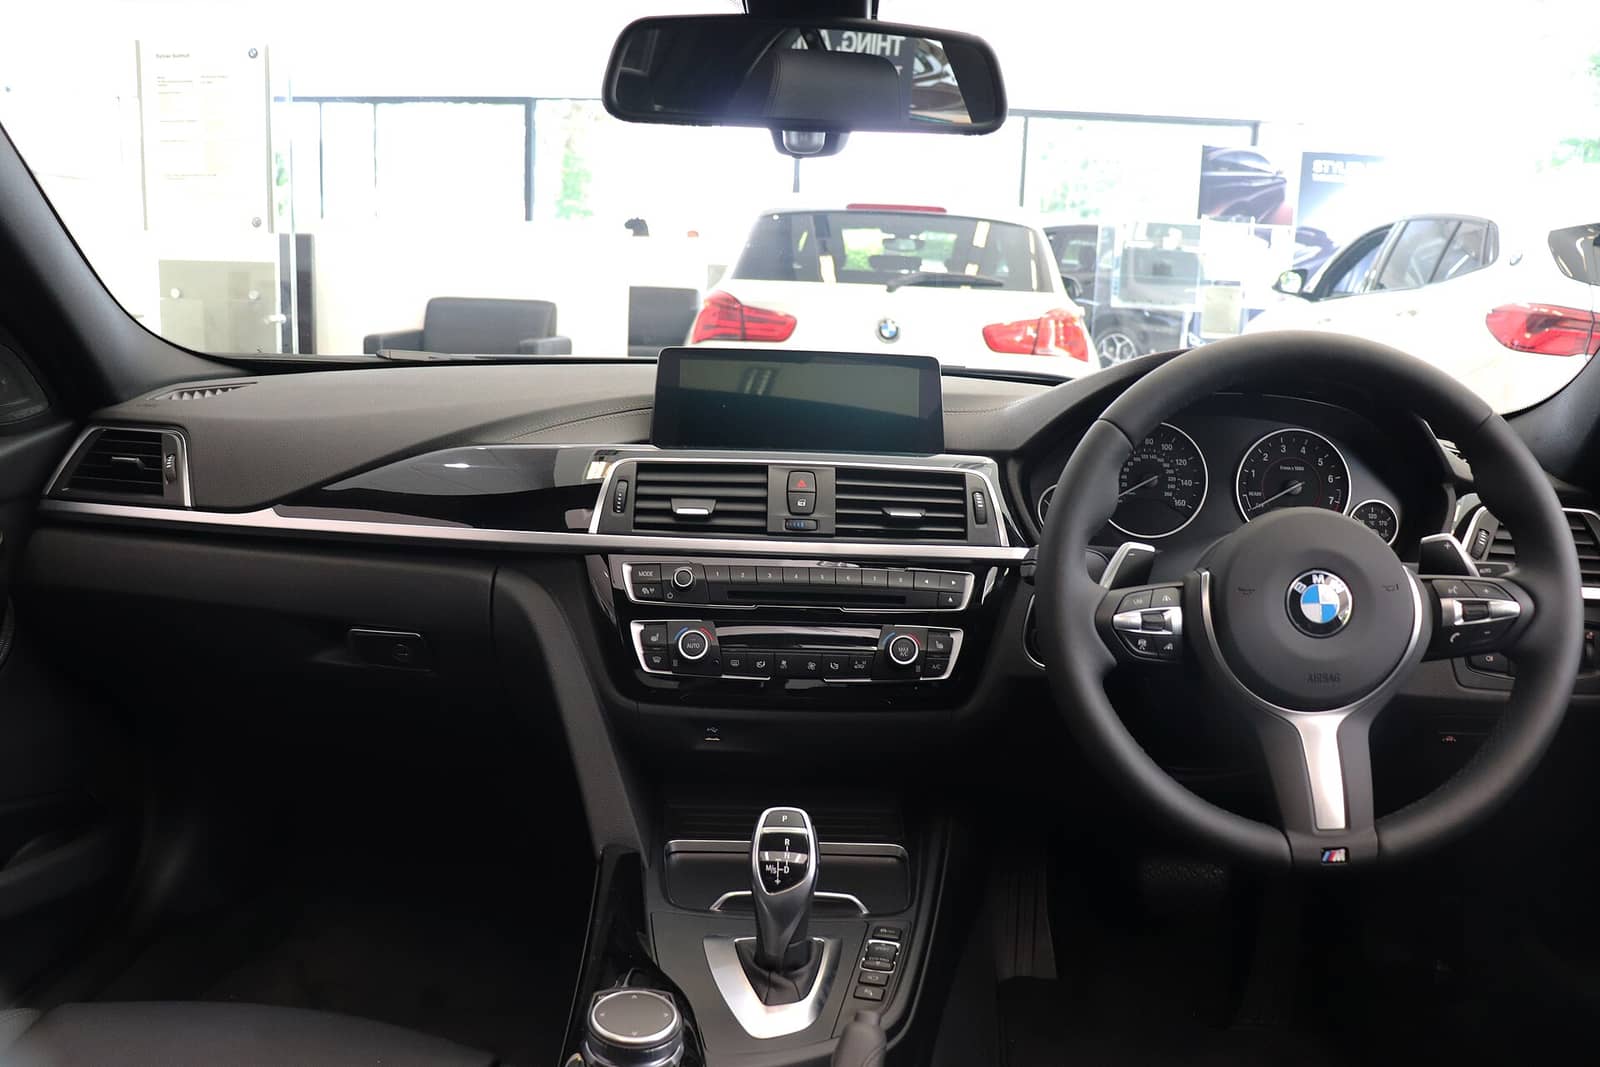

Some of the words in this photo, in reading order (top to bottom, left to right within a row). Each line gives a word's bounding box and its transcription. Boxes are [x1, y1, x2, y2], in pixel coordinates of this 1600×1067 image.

[1161, 443, 1173, 451] 100
[1280, 444, 1287, 453] 3
[1300, 446, 1306, 454] 4
[1262, 453, 1269, 462] 2
[1317, 457, 1323, 466] 5
[1175, 458, 1188, 466] 120
[1251, 469, 1256, 478] 1
[1181, 479, 1193, 487] 140
[1327, 475, 1334, 483] 6
[1174, 499, 1186, 507] 160
[1328, 496, 1334, 505] 7
[784, 838, 790, 846] R
[783, 865, 790, 874] D
